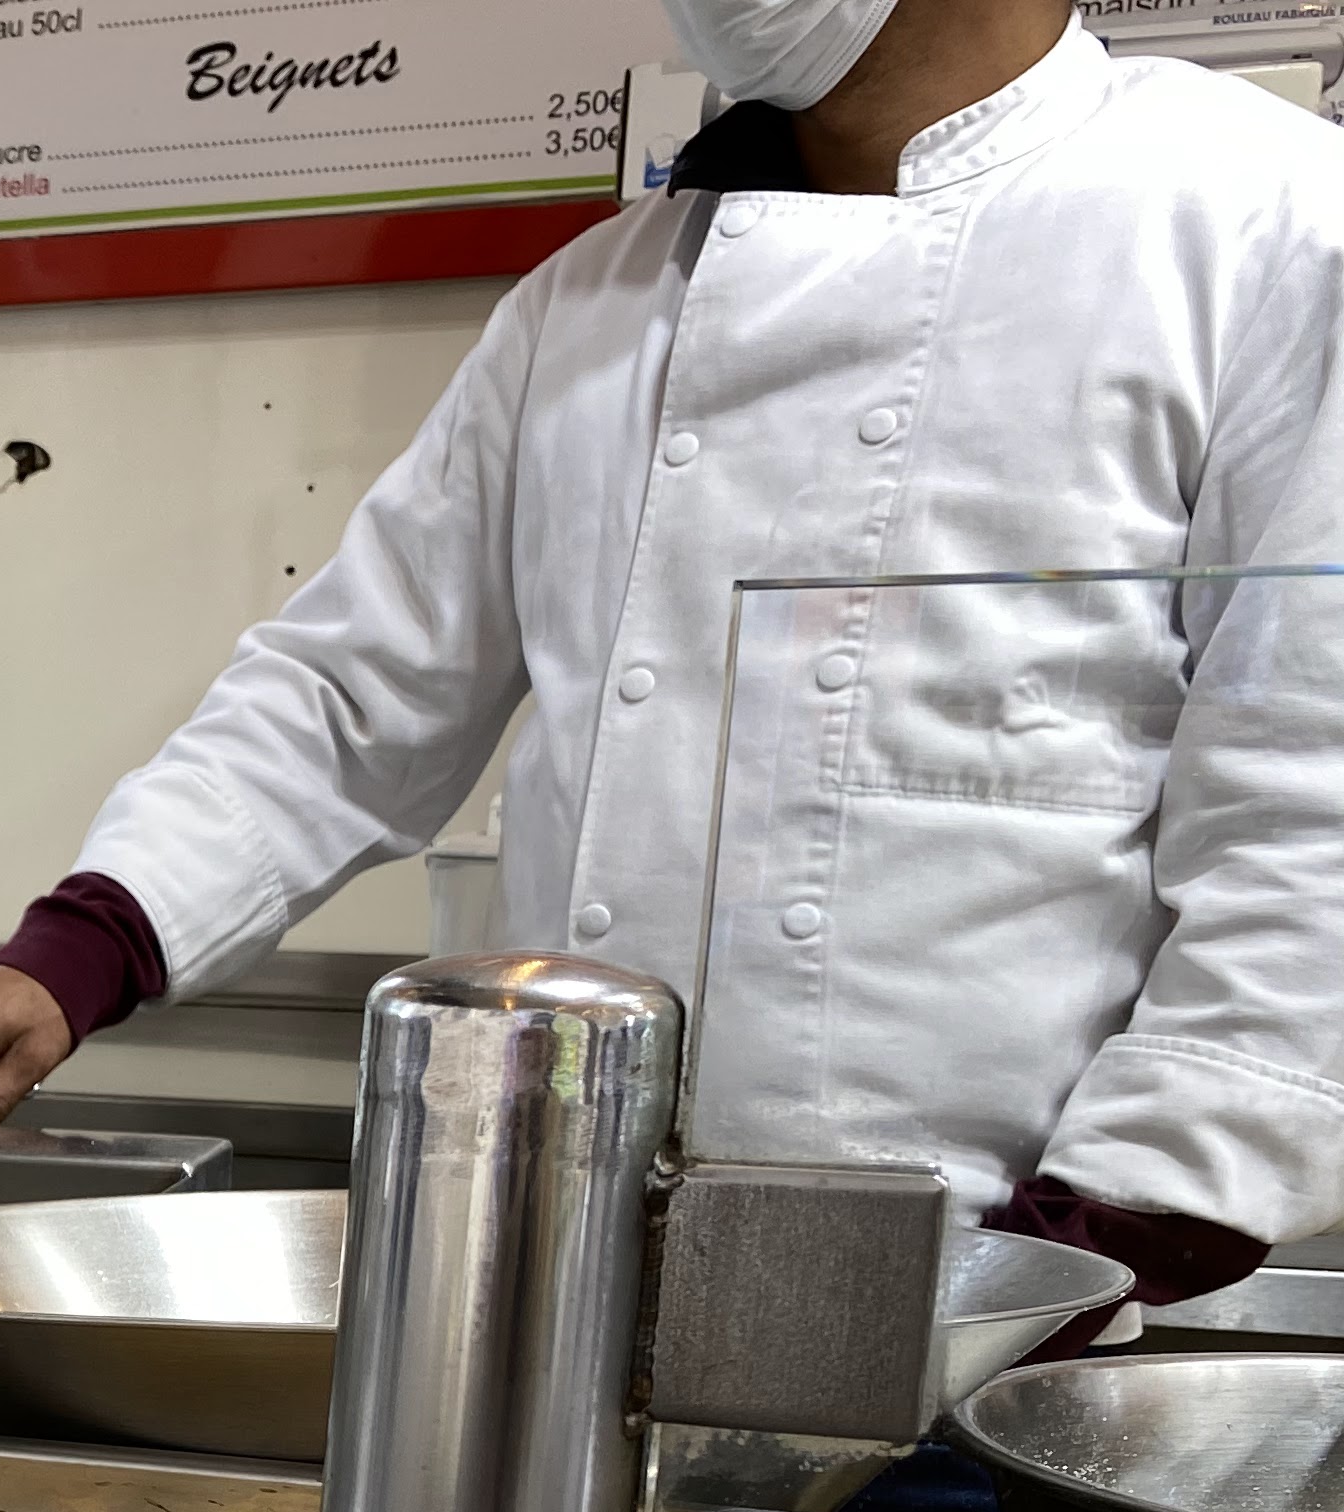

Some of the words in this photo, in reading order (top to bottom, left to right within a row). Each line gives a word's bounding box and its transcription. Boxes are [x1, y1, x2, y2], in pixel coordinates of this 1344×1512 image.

[31, 7, 83, 36] 50cl
[186, 40, 400, 113] Beignets
[548, 88, 625, 121] 2,50€
[545, 125, 621, 158] 3,50€
